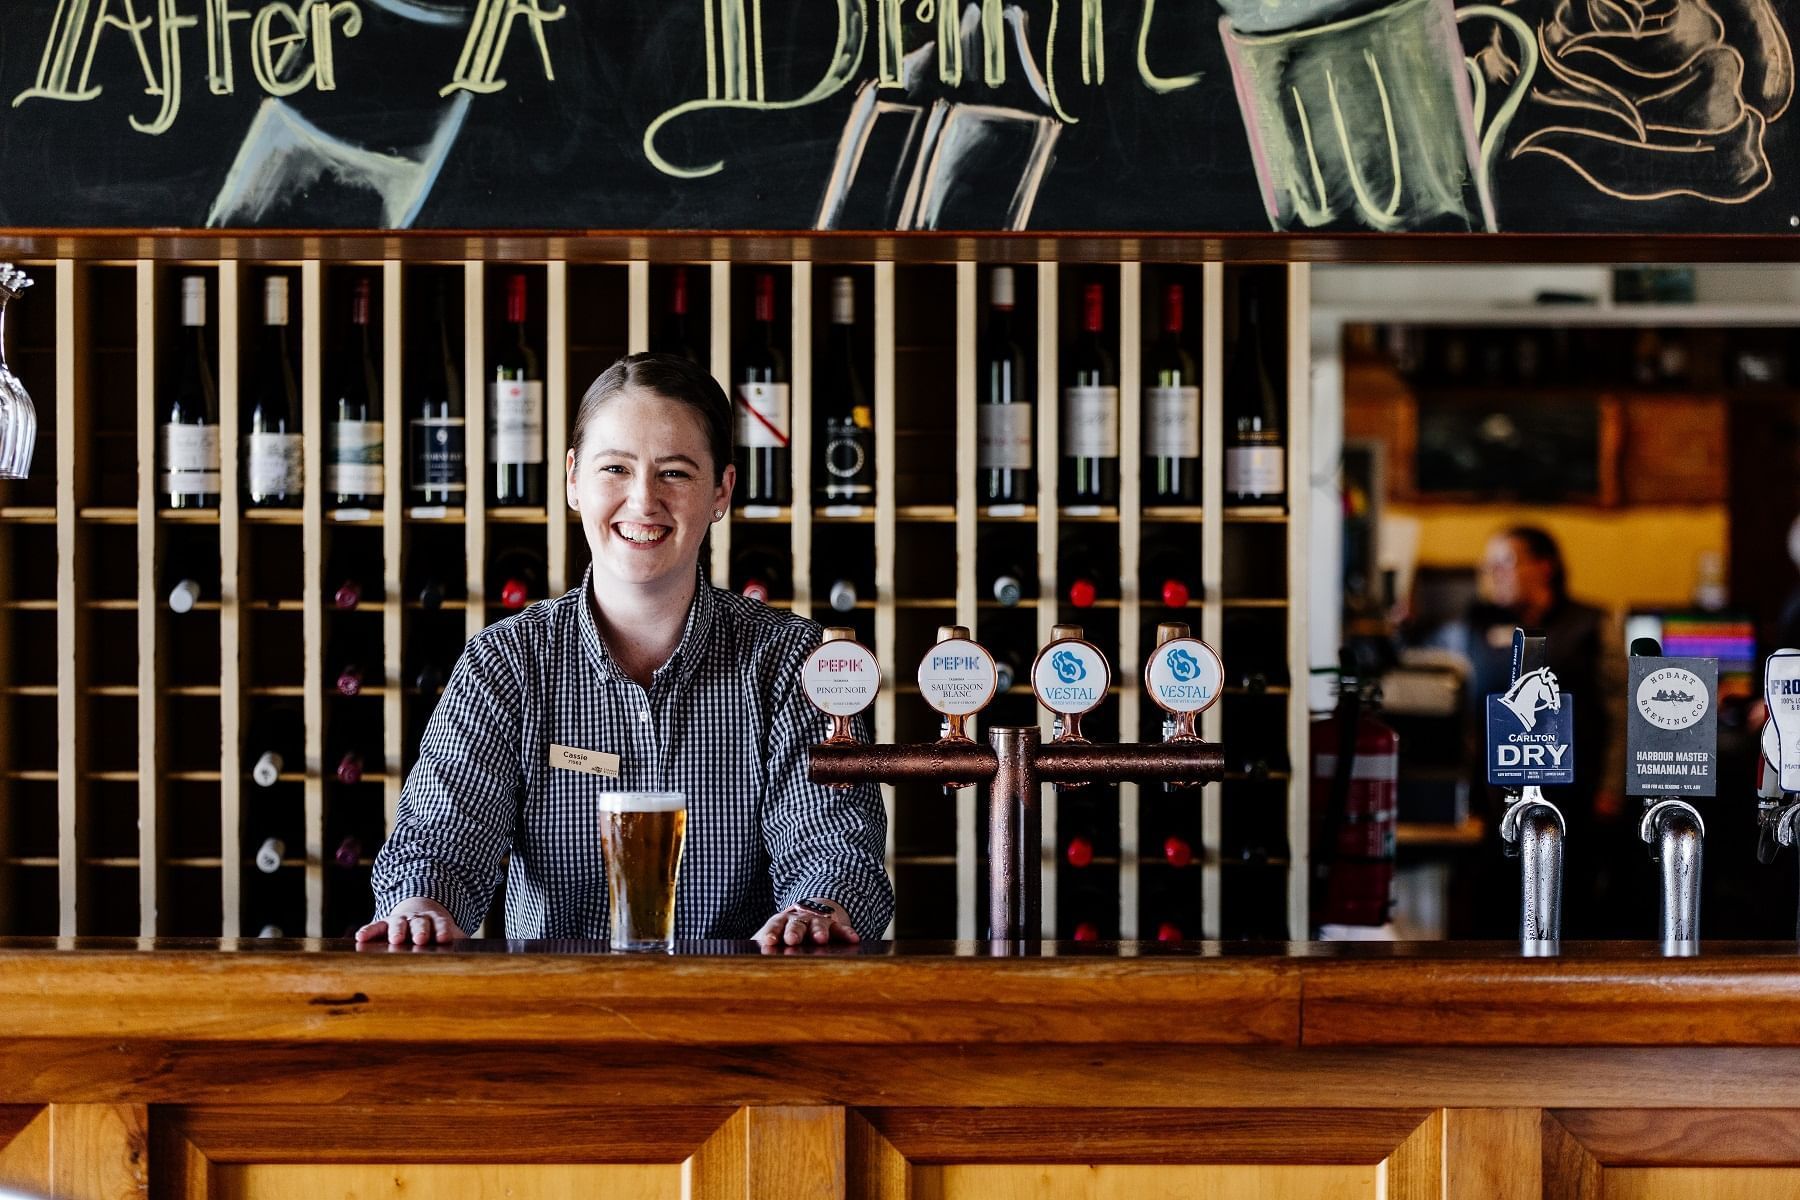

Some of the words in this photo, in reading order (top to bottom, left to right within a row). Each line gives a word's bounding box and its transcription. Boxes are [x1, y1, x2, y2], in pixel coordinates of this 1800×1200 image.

[818, 659, 863, 672] PEPIK
[933, 657, 980, 670] PEPIK
[1650, 672, 1696, 686] HOBART
[816, 686, 844, 694] PINOT
[844, 686, 868, 694] NOIR
[931, 683, 983, 691] SAUVIGNON
[1045, 687, 1097, 700] VESTAL
[1159, 685, 1211, 699] VESTAL
[943, 690, 972, 698] BLANC
[1641, 699, 1688, 725] BREWING
[1691, 700, 1704, 717] CO.
[1508, 734, 1556, 742] CARLTON
[563, 751, 588, 761] Cassie
[1497, 744, 1569, 766] DRY
[1636, 751, 1674, 761] HARBOUR
[1675, 752, 1709, 762] MASTER
[1636, 763, 1688, 775] TASMANIAN
[1690, 764, 1709, 776] ALE
